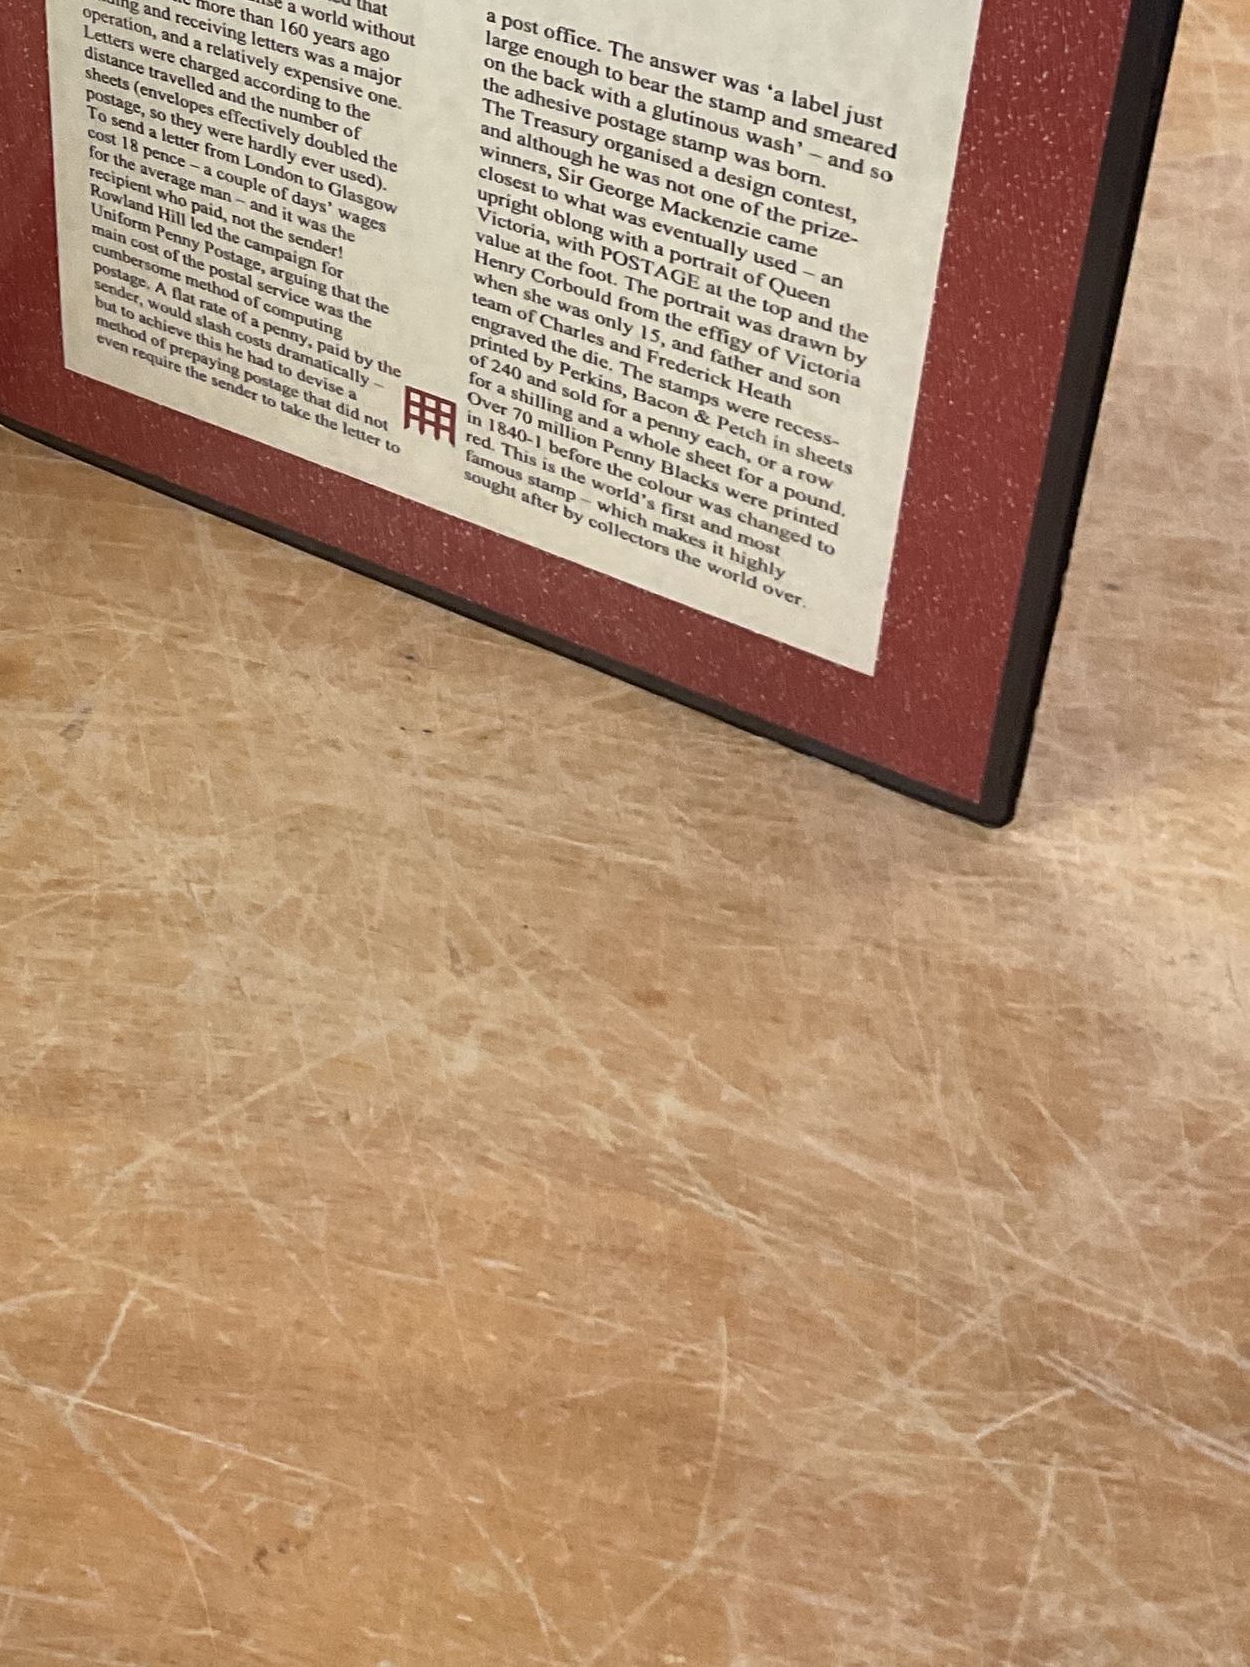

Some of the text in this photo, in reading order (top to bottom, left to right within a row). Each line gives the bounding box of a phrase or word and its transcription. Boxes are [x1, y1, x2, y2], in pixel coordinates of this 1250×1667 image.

[143, 4, 171, 21] and
[174, 13, 247, 46] receiving
[251, 30, 299, 58] letters
[303, 49, 335, 68] was
[339, 60, 349, 73] a
[353, 64, 402, 87] major
[485, 10, 883, 130] a post office. The answer was ‘a label just
[85, 88, 387, 192] postage, so they were hardly ever used).
[481, 97, 857, 224] The Treasury organised a design contest,
[89, 182, 344, 280] Rowland Hill led the campaign for
[477, 206, 869, 344] Victoria, with POSTAGE at the top and the
[96, 334, 401, 454] even require the sender to take the letter to
[472, 292, 791, 410] team of Charles and Frederick Heath
[466, 409, 835, 556] in 1840-1 before the colour was changed to
